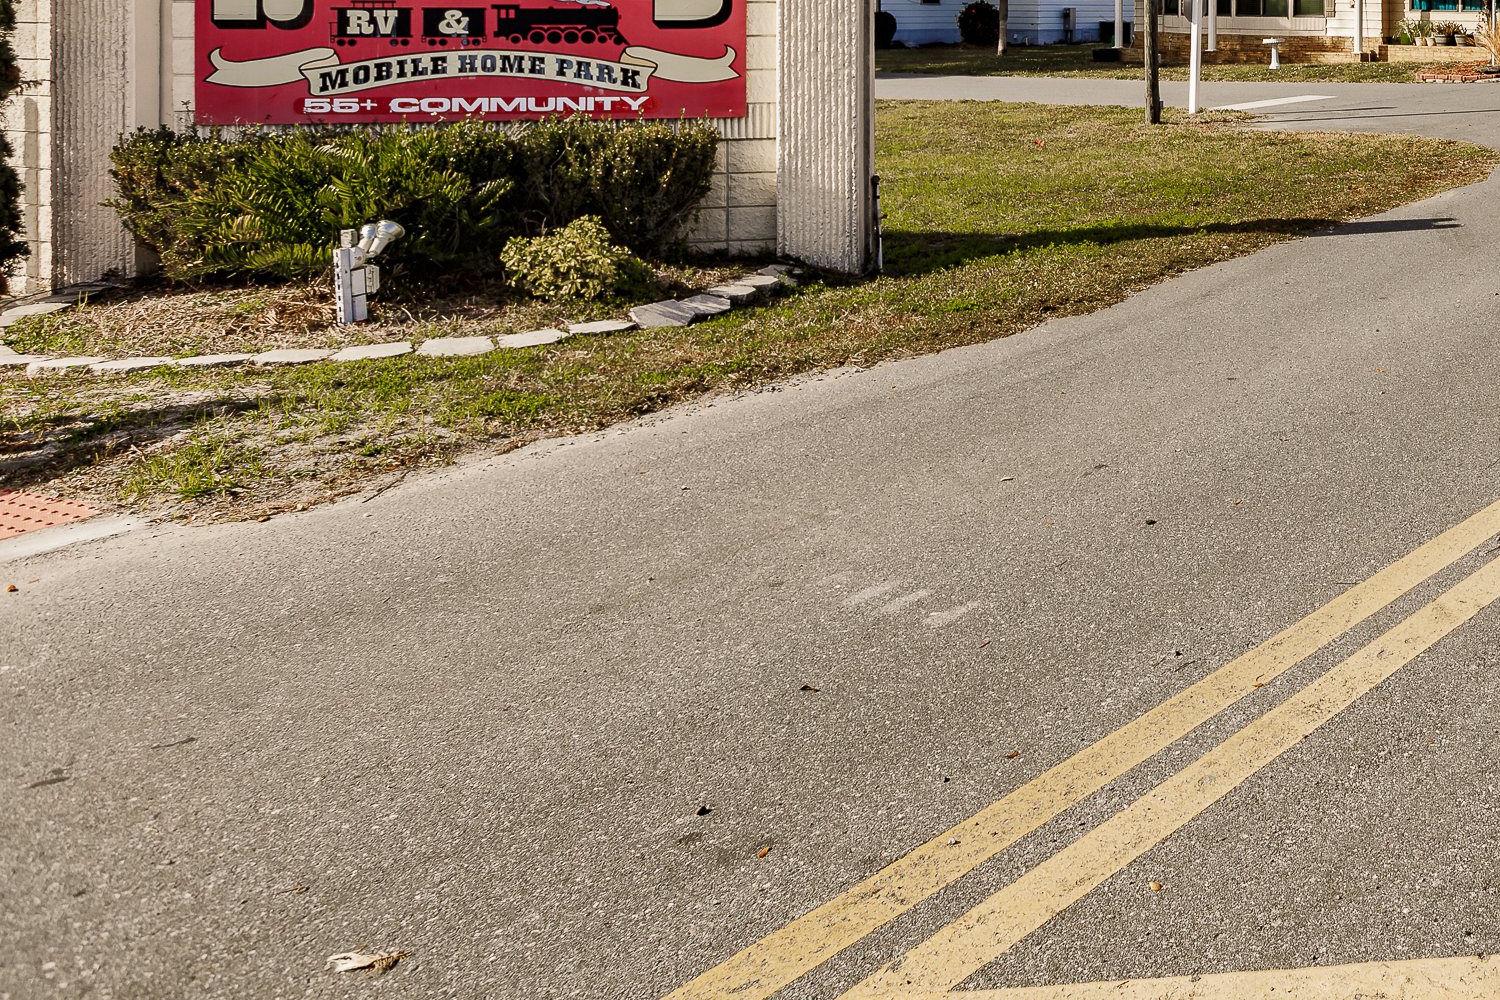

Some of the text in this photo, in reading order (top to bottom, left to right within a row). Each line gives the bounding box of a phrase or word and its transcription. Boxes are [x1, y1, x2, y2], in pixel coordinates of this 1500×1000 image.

[346, 8, 470, 35] RV &
[318, 54, 641, 92] MOBILE HOME PARK
[303, 96, 650, 114] 55+ COMMUNITY
